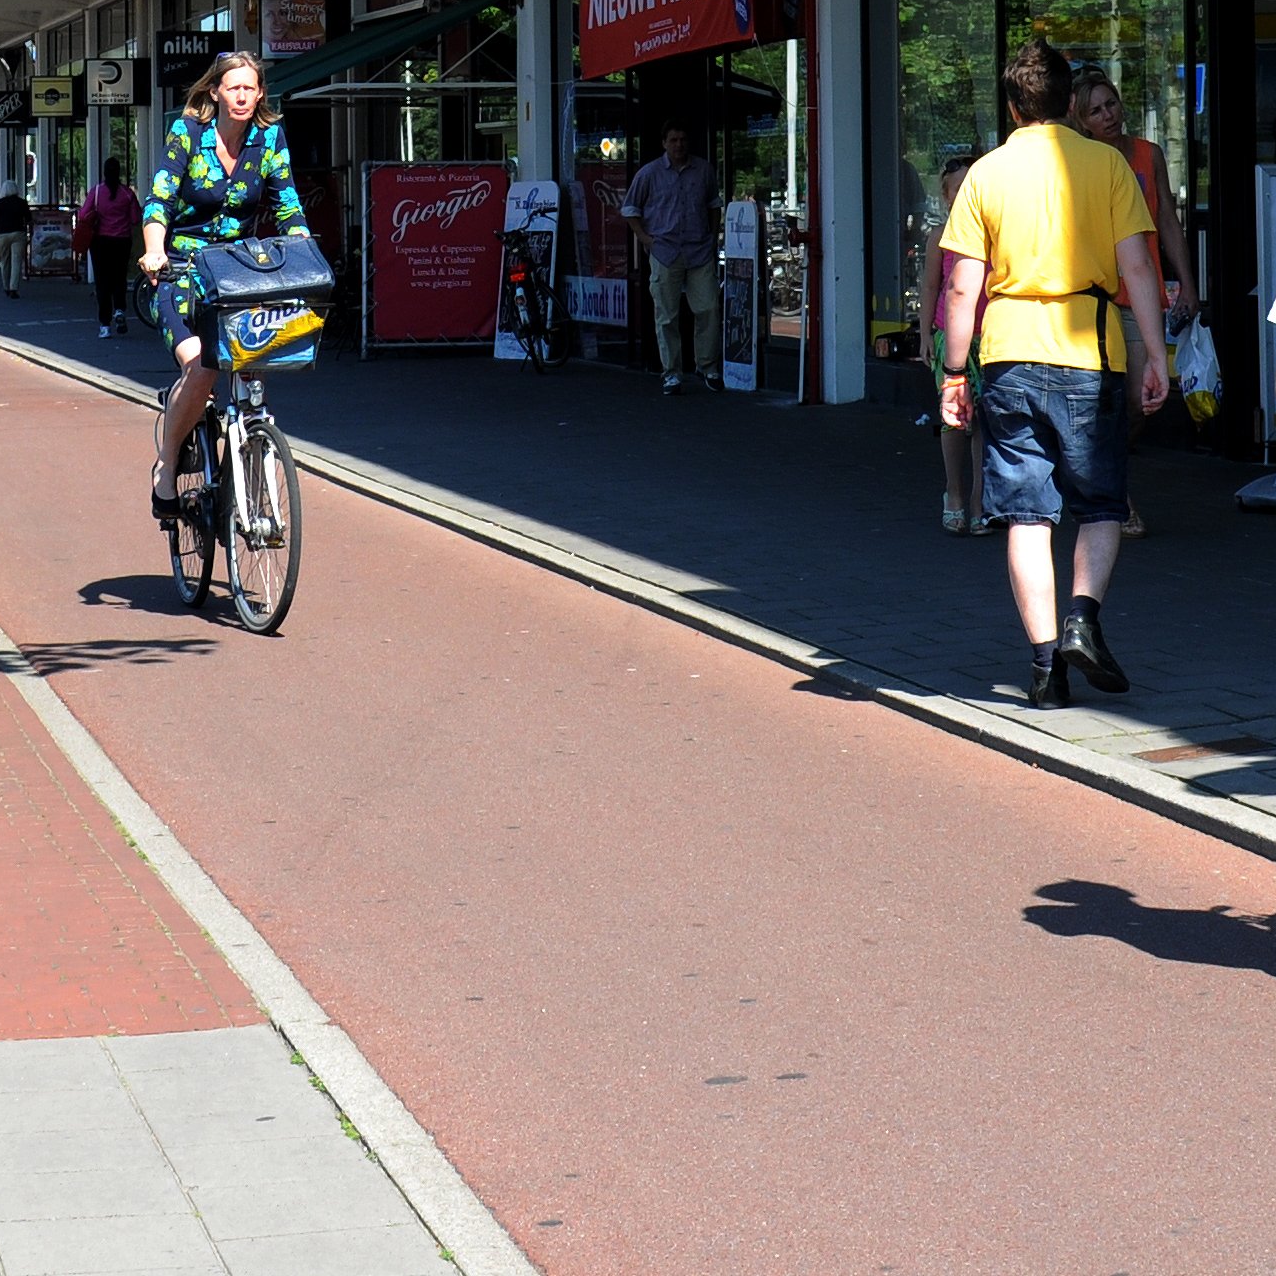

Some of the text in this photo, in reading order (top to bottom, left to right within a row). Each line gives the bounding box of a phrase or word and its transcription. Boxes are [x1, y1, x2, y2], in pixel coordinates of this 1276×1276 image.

[164, 35, 209, 54] nikki
[396, 173, 437, 183] Ristorante
[448, 173, 480, 182] Pizzeria
[390, 180, 492, 243] Giorgio
